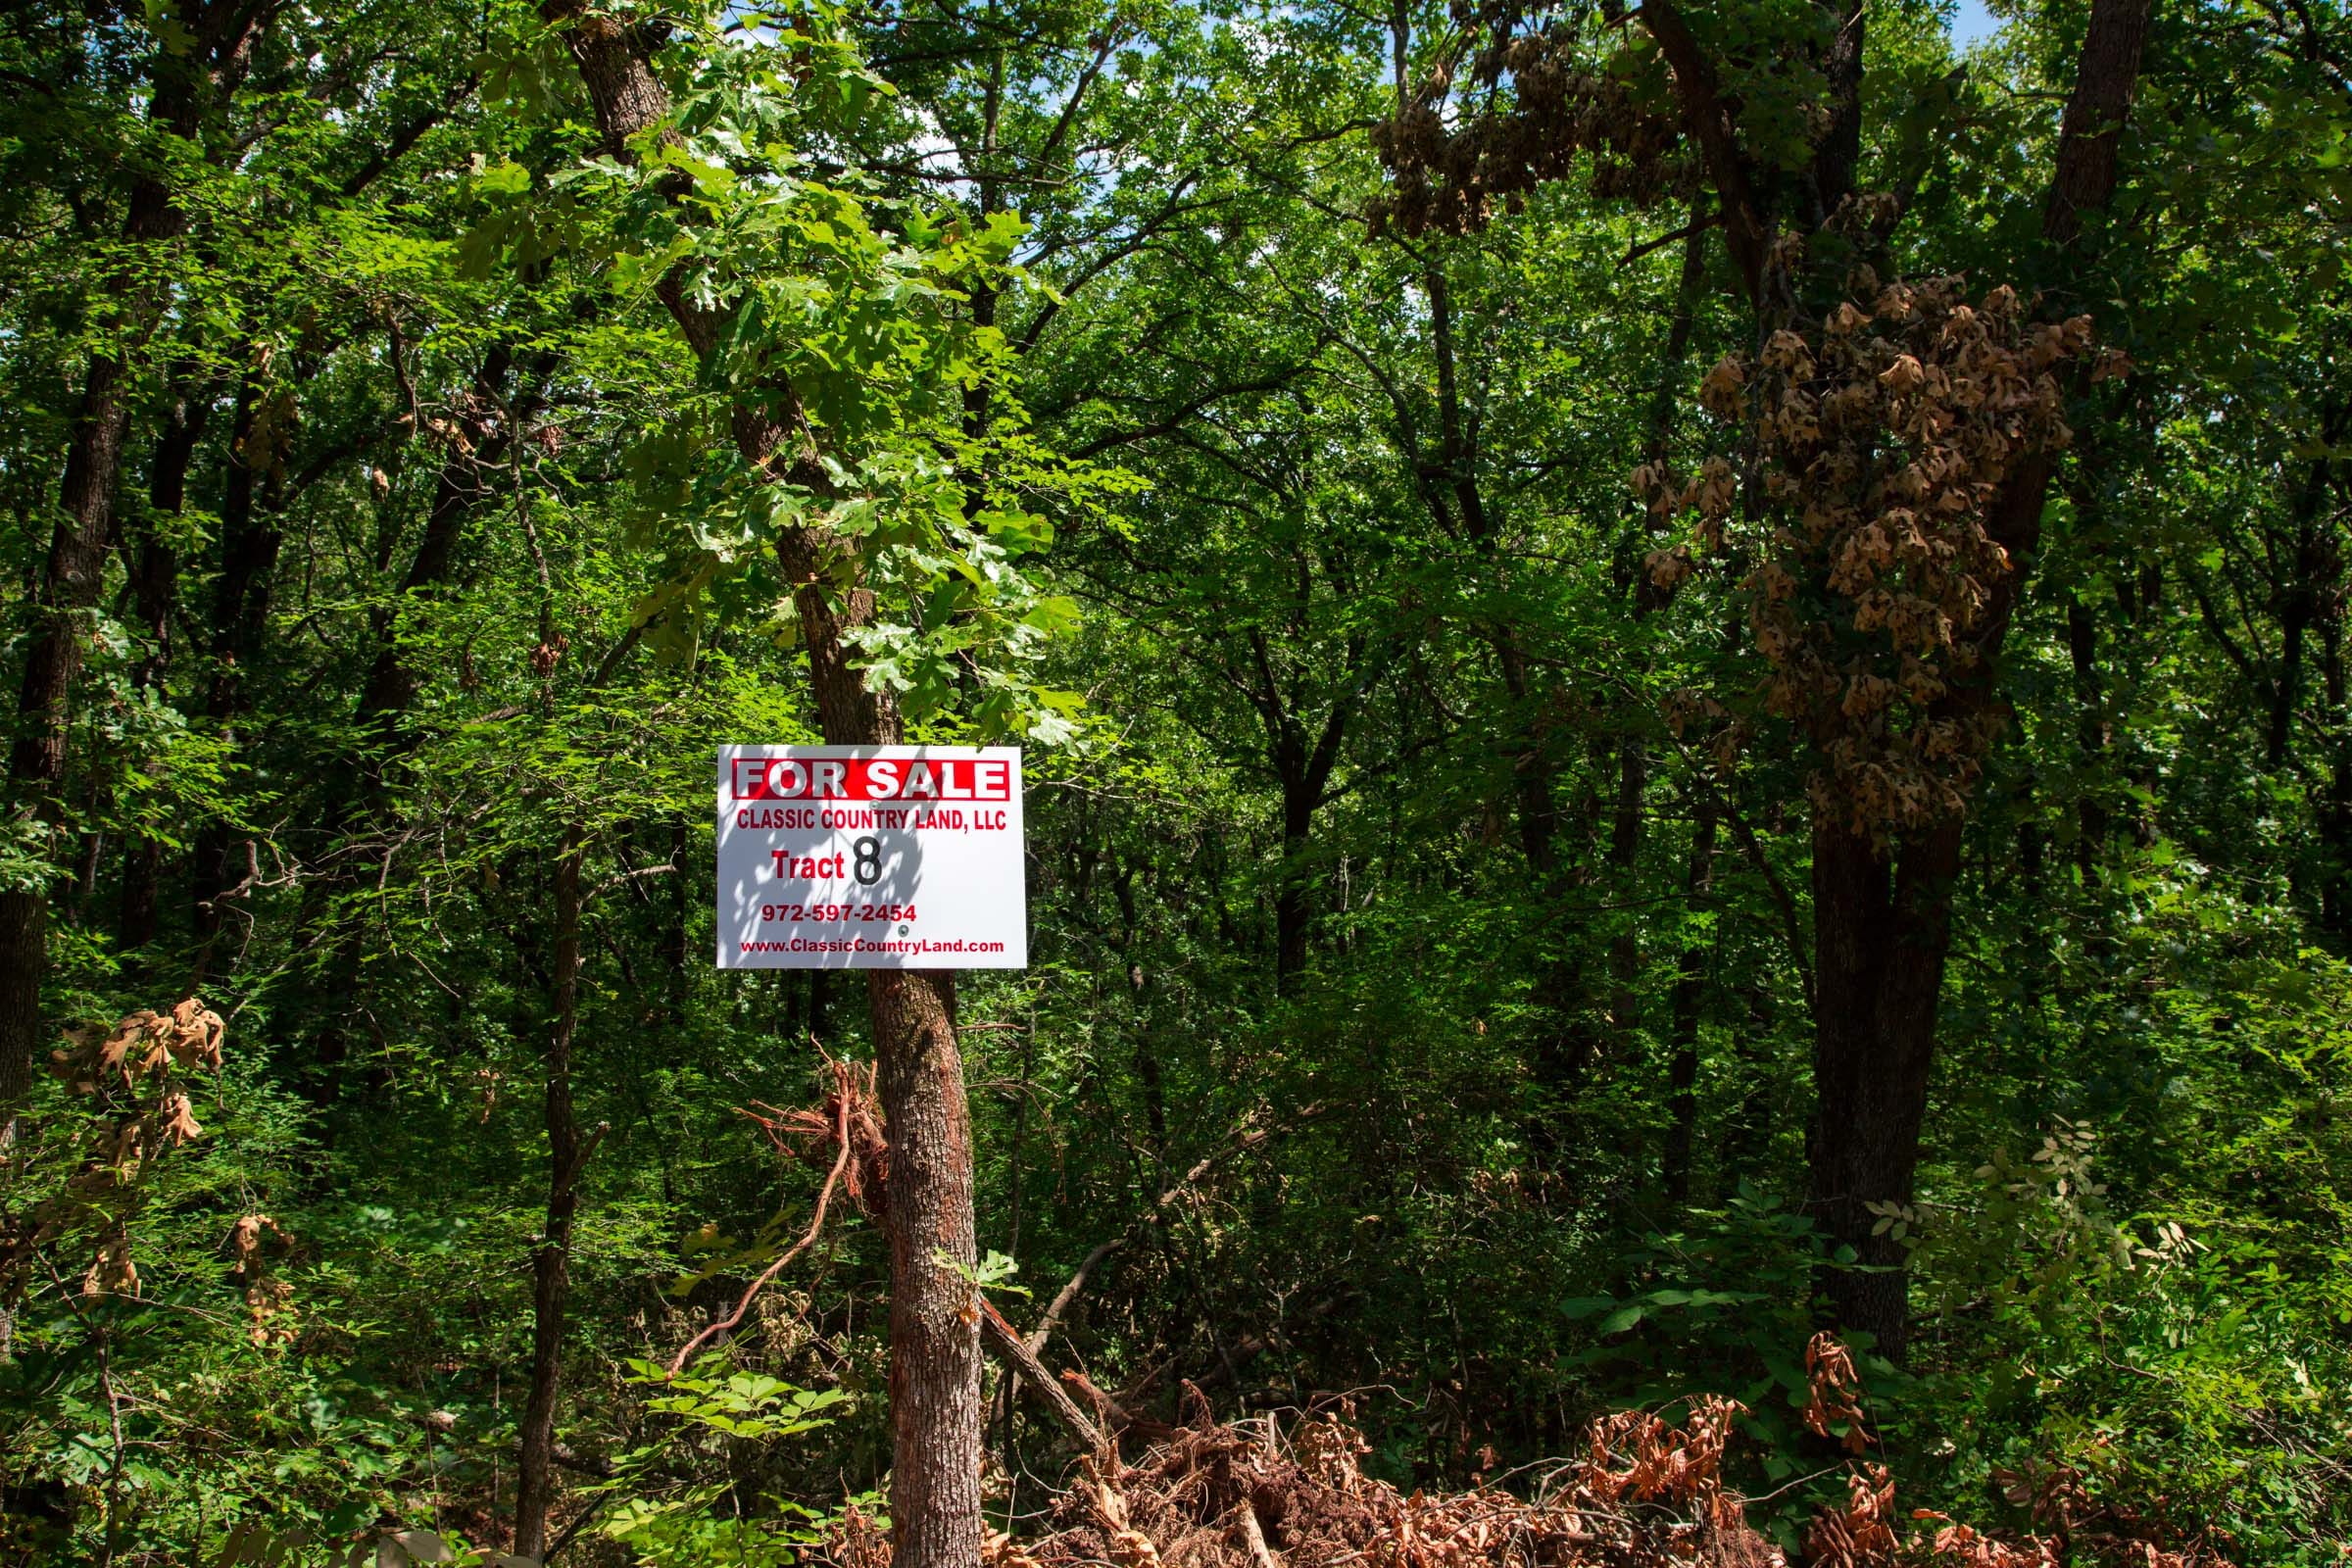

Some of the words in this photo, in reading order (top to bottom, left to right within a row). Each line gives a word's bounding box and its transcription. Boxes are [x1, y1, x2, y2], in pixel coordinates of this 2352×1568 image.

[736, 760, 848, 798] FOR
[866, 761, 1006, 799] SALE
[737, 808, 815, 830] CLASSIC
[821, 809, 909, 830] COUNTRY
[915, 809, 968, 834] LAND,
[974, 809, 1006, 830] LLC
[771, 850, 844, 879] Tract
[853, 836, 882, 886] 8
[761, 905, 916, 922] 972-597-2454
[741, 938, 1004, 956] www.ClassicCountryLand.com
